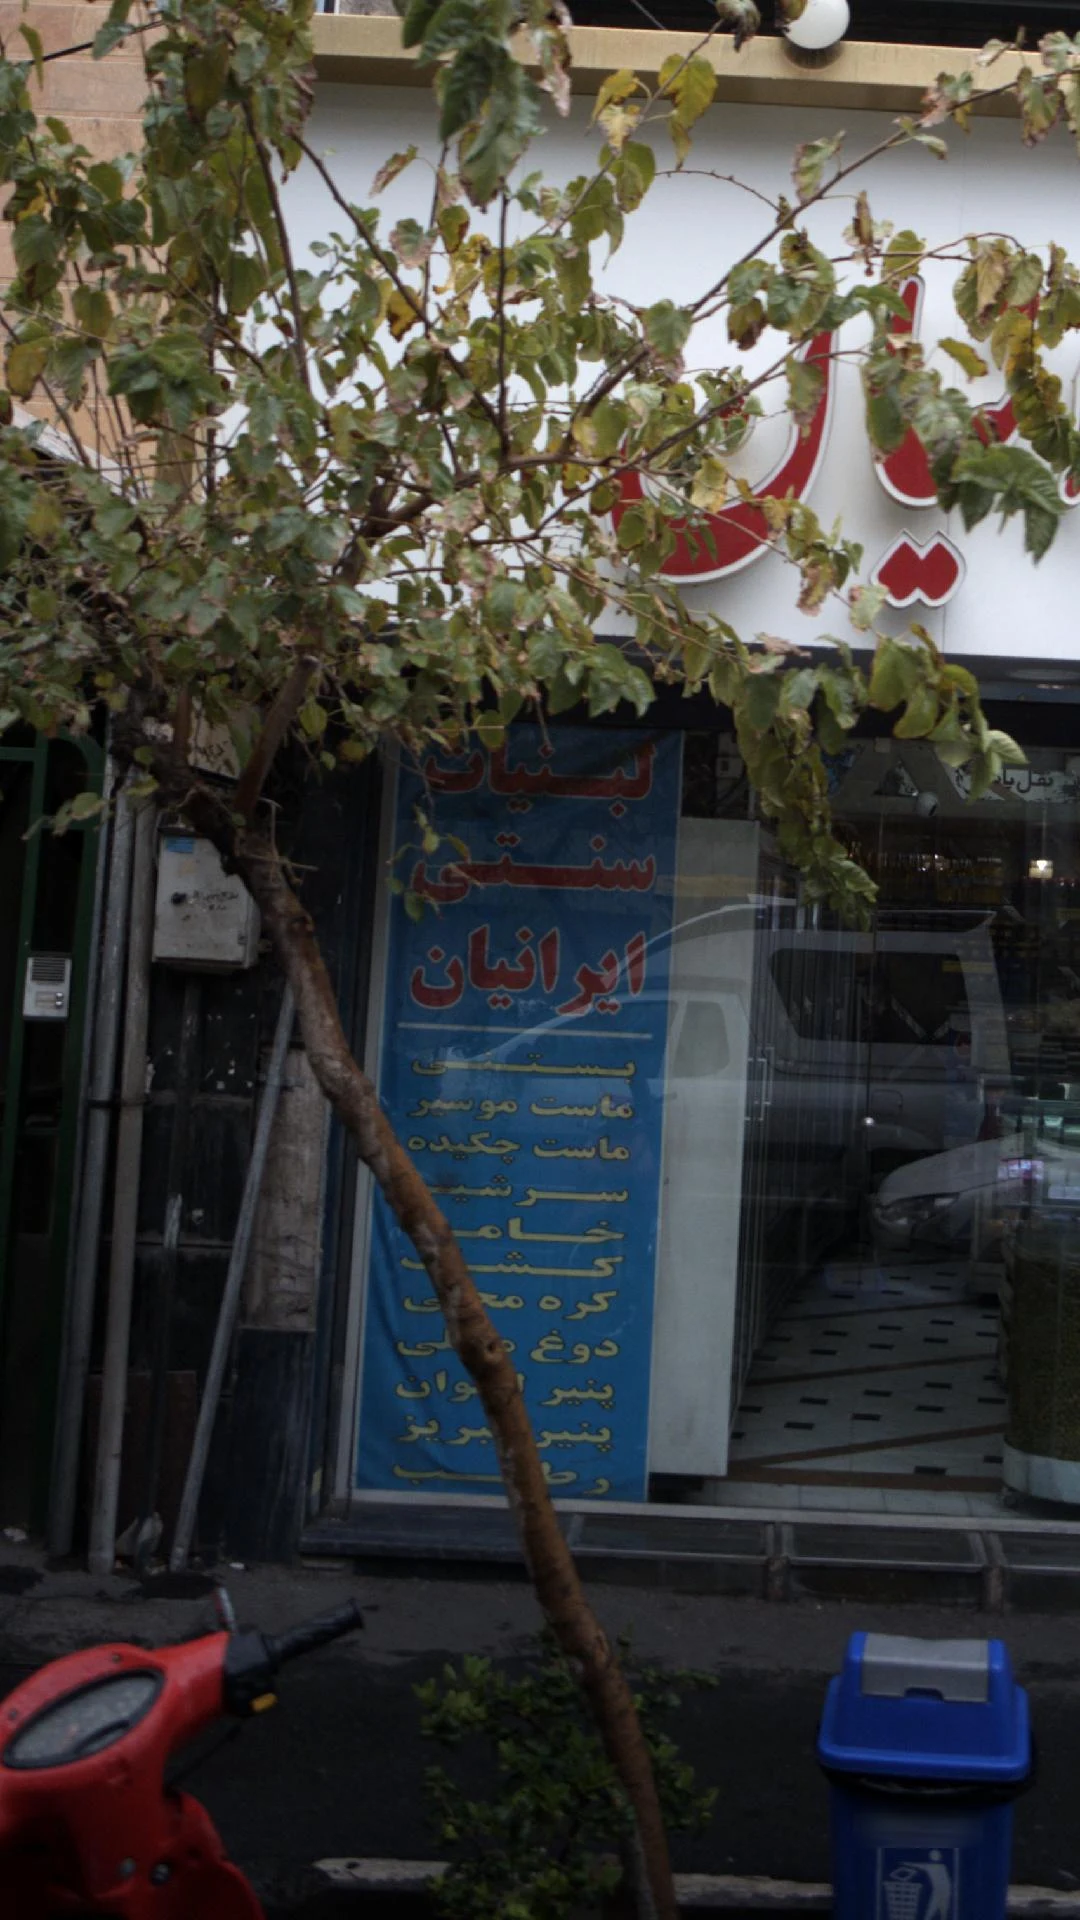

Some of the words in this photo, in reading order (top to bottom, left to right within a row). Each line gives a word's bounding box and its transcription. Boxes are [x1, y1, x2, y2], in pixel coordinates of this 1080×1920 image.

[424, 739, 657, 818] لبنیات
[411, 834, 656, 904] سنتی
[410, 924, 647, 1017] ایرانیان
[411, 1052, 637, 1084] بستنی
[408, 1094, 519, 1121] موسیر
[529, 1094, 635, 1120] ماست
[407, 1131, 521, 1165] چکیده
[532, 1135, 630, 1161] ماست
[451, 1216, 626, 1244] خام
[537, 1290, 619, 1321] کره
[529, 1329, 621, 1365] دوغ
[540, 1377, 615, 1409] پنیر
[536, 1420, 613, 1452] پنیر
